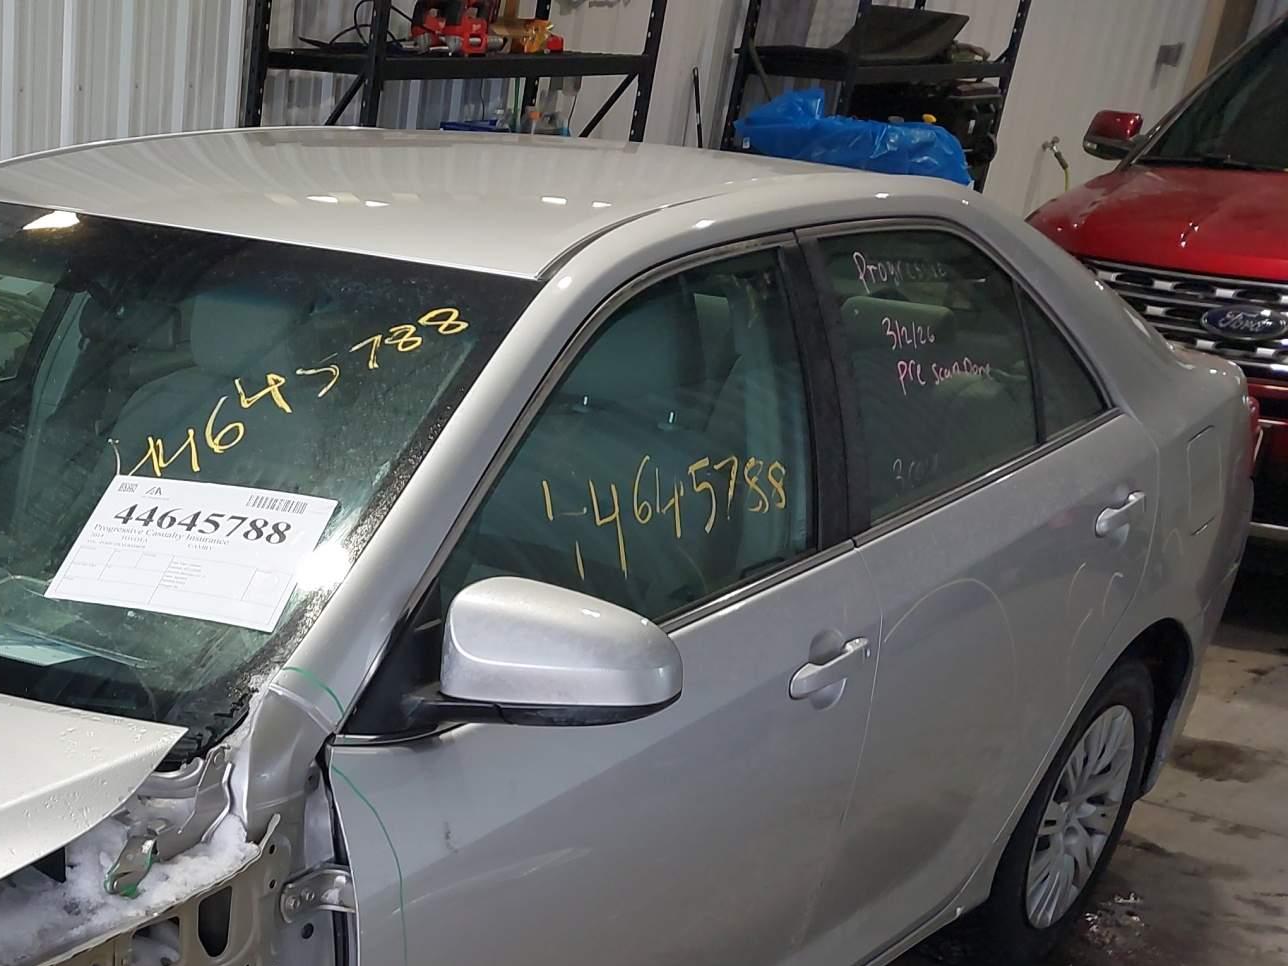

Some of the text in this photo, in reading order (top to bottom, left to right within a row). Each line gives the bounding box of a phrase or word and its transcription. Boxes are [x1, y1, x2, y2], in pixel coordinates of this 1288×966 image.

[93, 523, 230, 546] Progressive Casualty Insurance
[114, 503, 291, 545] 44645788
